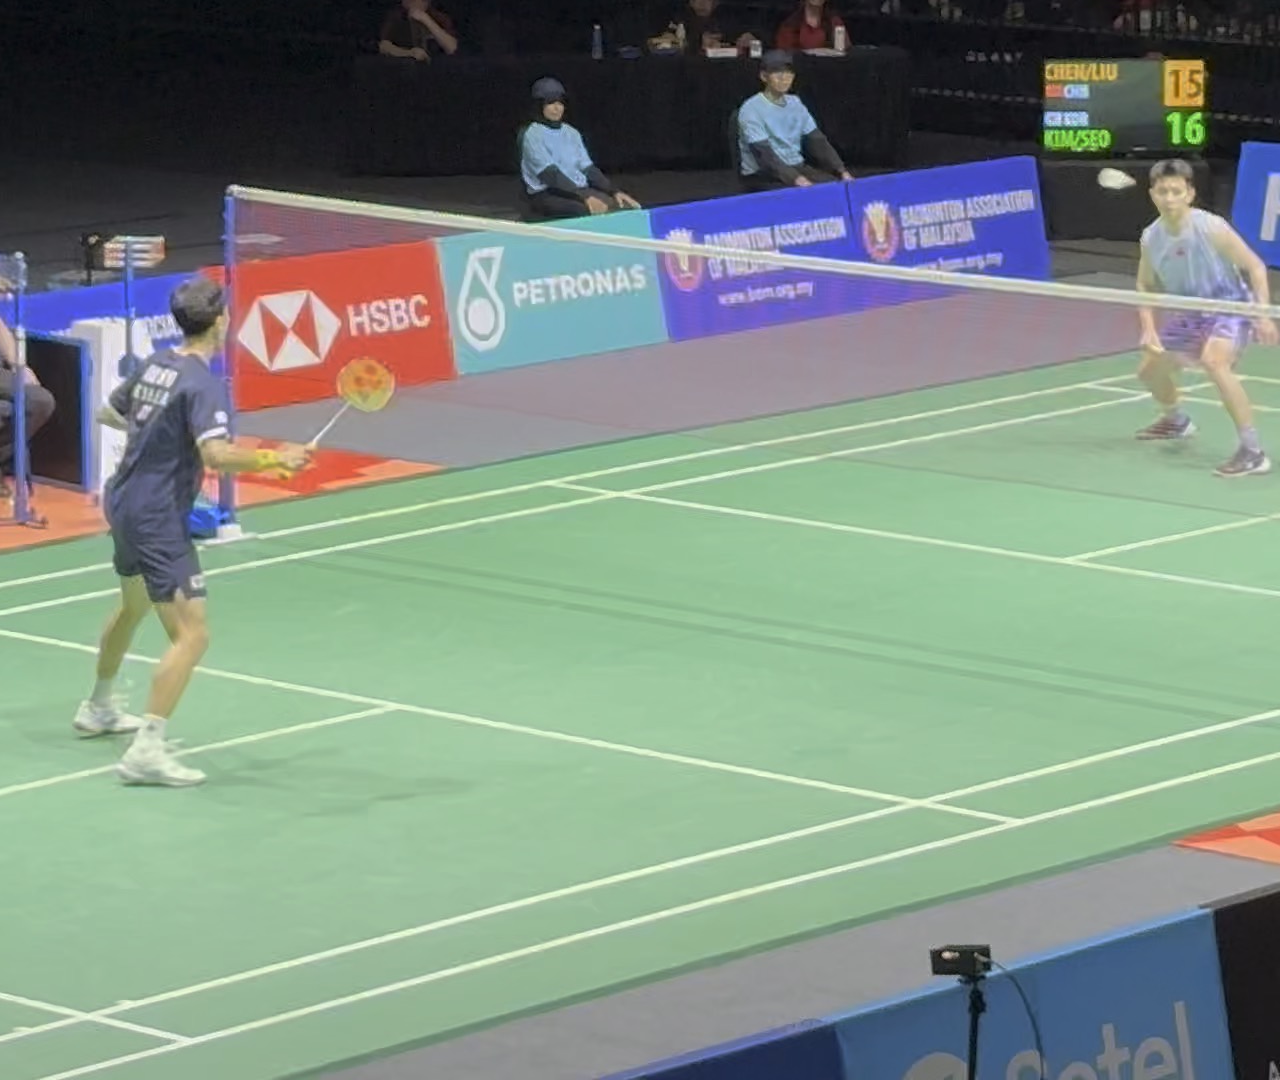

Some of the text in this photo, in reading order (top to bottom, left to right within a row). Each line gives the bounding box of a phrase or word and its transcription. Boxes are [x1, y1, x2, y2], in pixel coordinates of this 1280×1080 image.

[1045, 62, 1202, 98] CHEN/LIU 15
[1044, 111, 1206, 150] KIM/SEO 16
[966, 189, 1035, 218] ASSOCIATION
[774, 216, 847, 247] ASSOCIATION
[903, 227, 917, 251] OF
[512, 263, 648, 308] PETRONAS
[346, 294, 432, 337] HSBC
